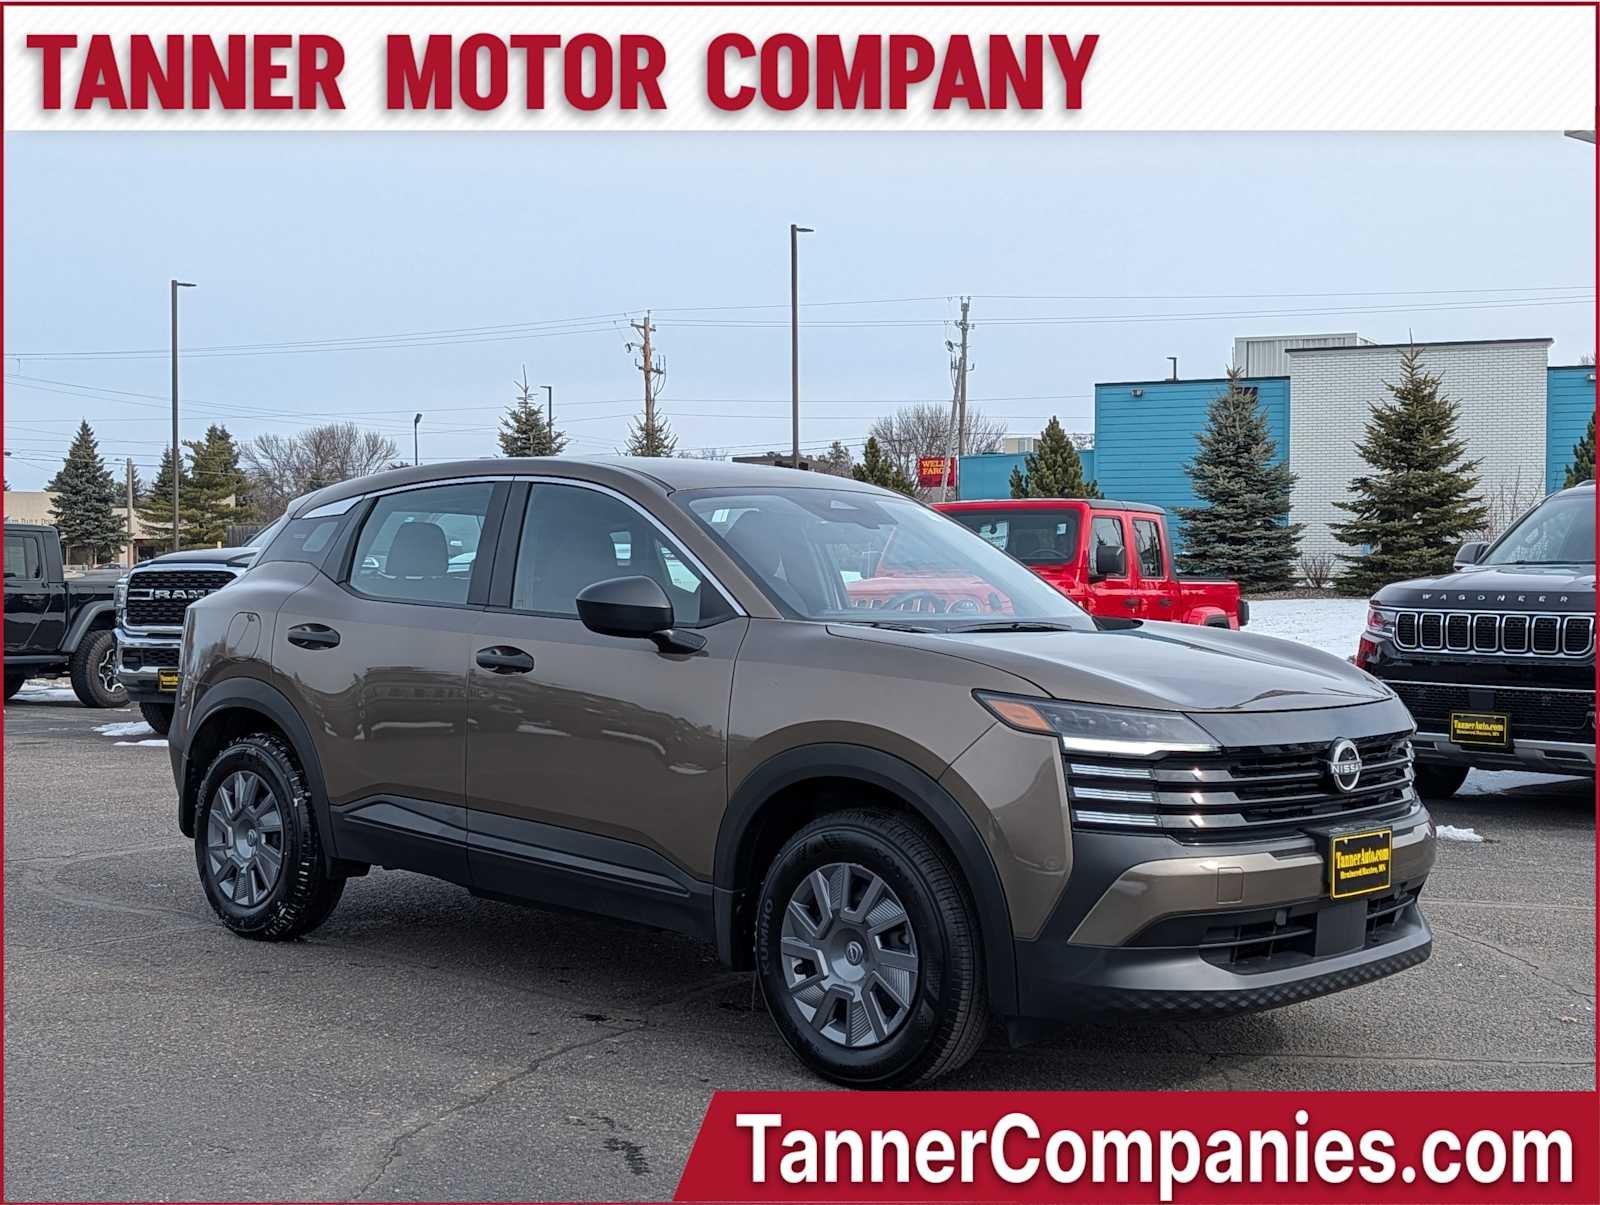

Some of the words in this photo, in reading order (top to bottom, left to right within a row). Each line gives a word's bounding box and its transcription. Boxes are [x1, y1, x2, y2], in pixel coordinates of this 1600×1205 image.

[154, 589, 206, 599] RAM
[1422, 594, 1568, 603] WAGONEER
[1336, 848, 1389, 869] TannerAuto.com
[760, 898, 774, 976] KUMHO
